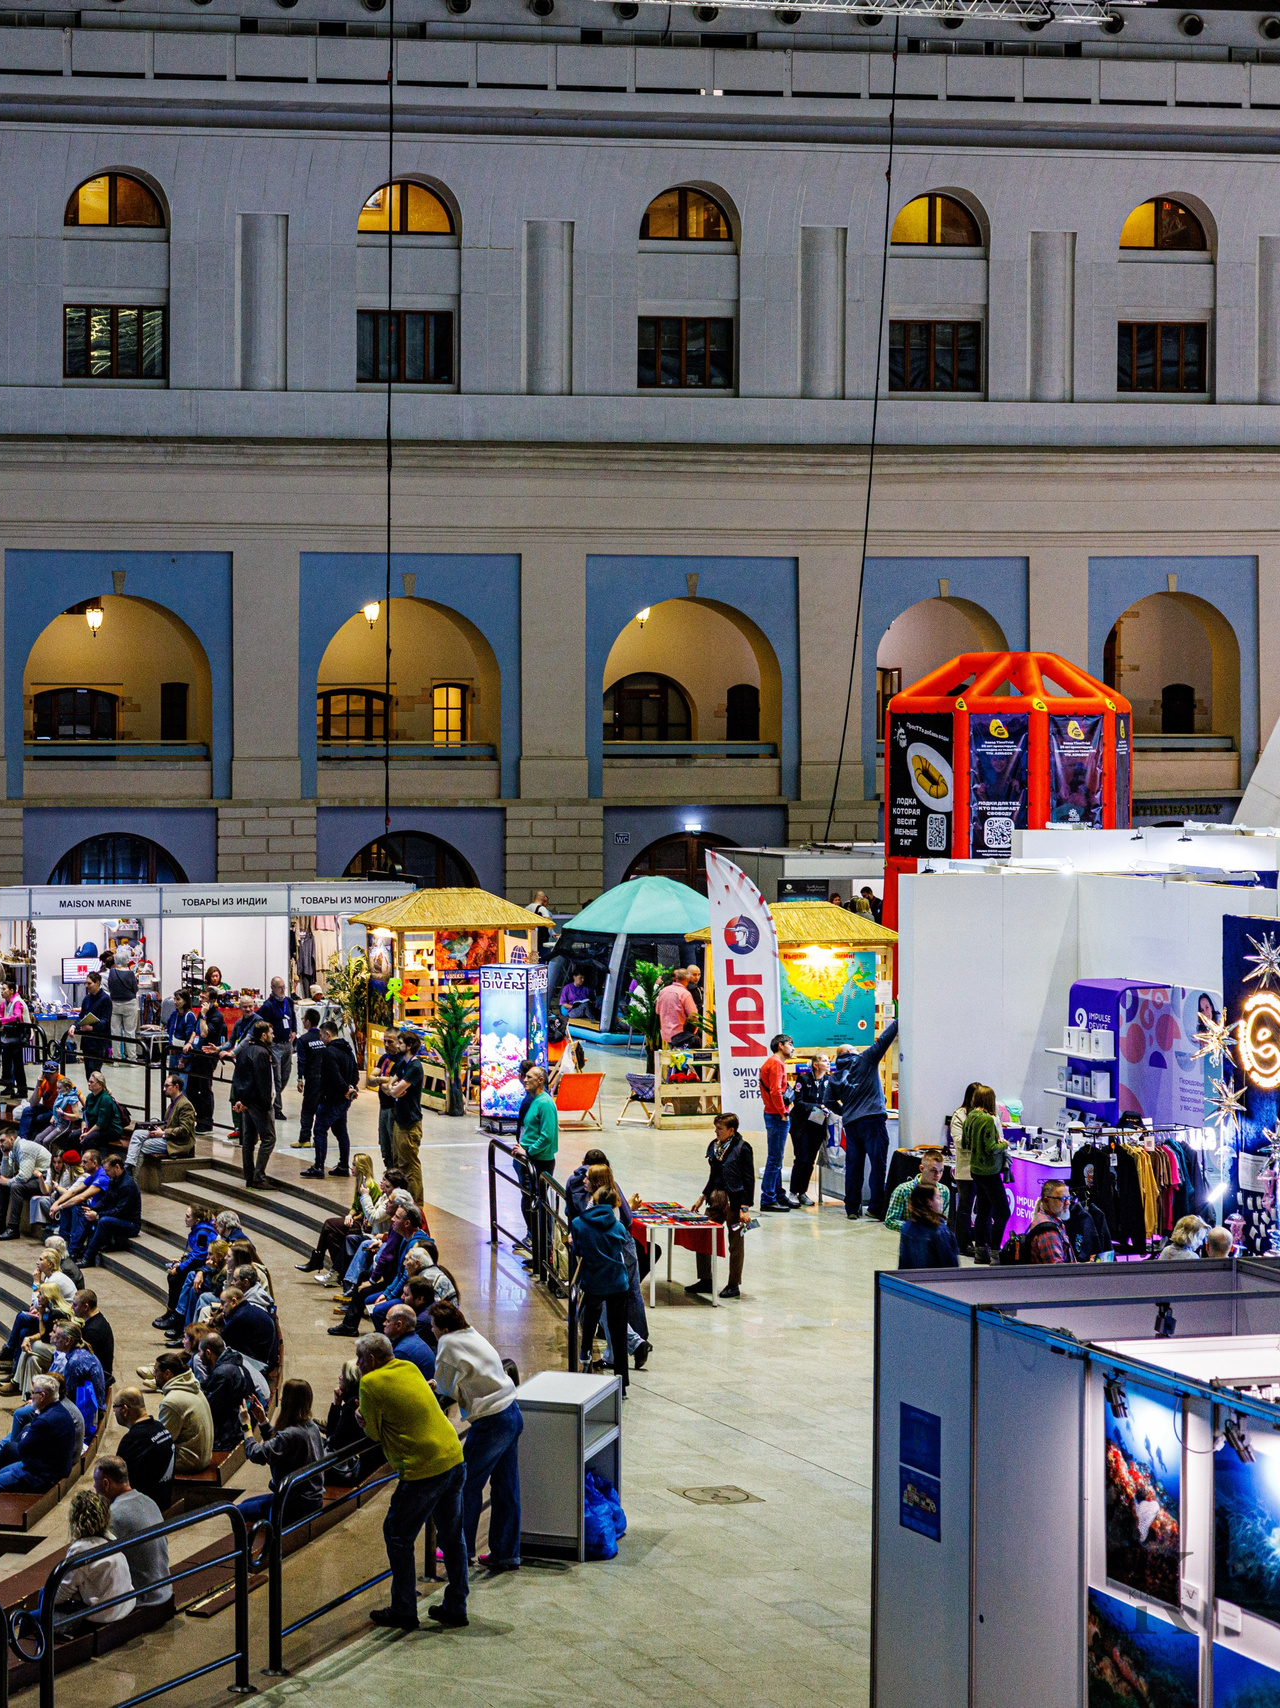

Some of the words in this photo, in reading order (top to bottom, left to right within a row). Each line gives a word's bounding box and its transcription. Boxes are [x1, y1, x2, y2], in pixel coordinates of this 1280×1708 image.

[896, 797, 917, 806] ЛОДКА
[892, 807, 921, 815] КОТОРАЯ
[1132, 804, 1223, 816] НТИКВАРИАТ
[894, 828, 918, 836] МЕНЬШЕ
[59, 899, 95, 908] MAISON
[97, 899, 132, 908] MARINE
[182, 898, 220, 906] ТОВАРЫ
[222, 898, 234, 906] ИЗ
[236, 897, 268, 906] ИНДИИ
[300, 897, 338, 905] ТОВАРЫ
[340, 896, 352, 904] ИЗ
[354, 896, 402, 904] МОНГОЛИ
[482, 971, 525, 981] EASY
[482, 980, 525, 990] DIVERS
[1088, 1012, 1111, 1023] IMPULSE
[1088, 1021, 1108, 1030] DEVICE
[1016, 1196, 1035, 1209] IMPUL
